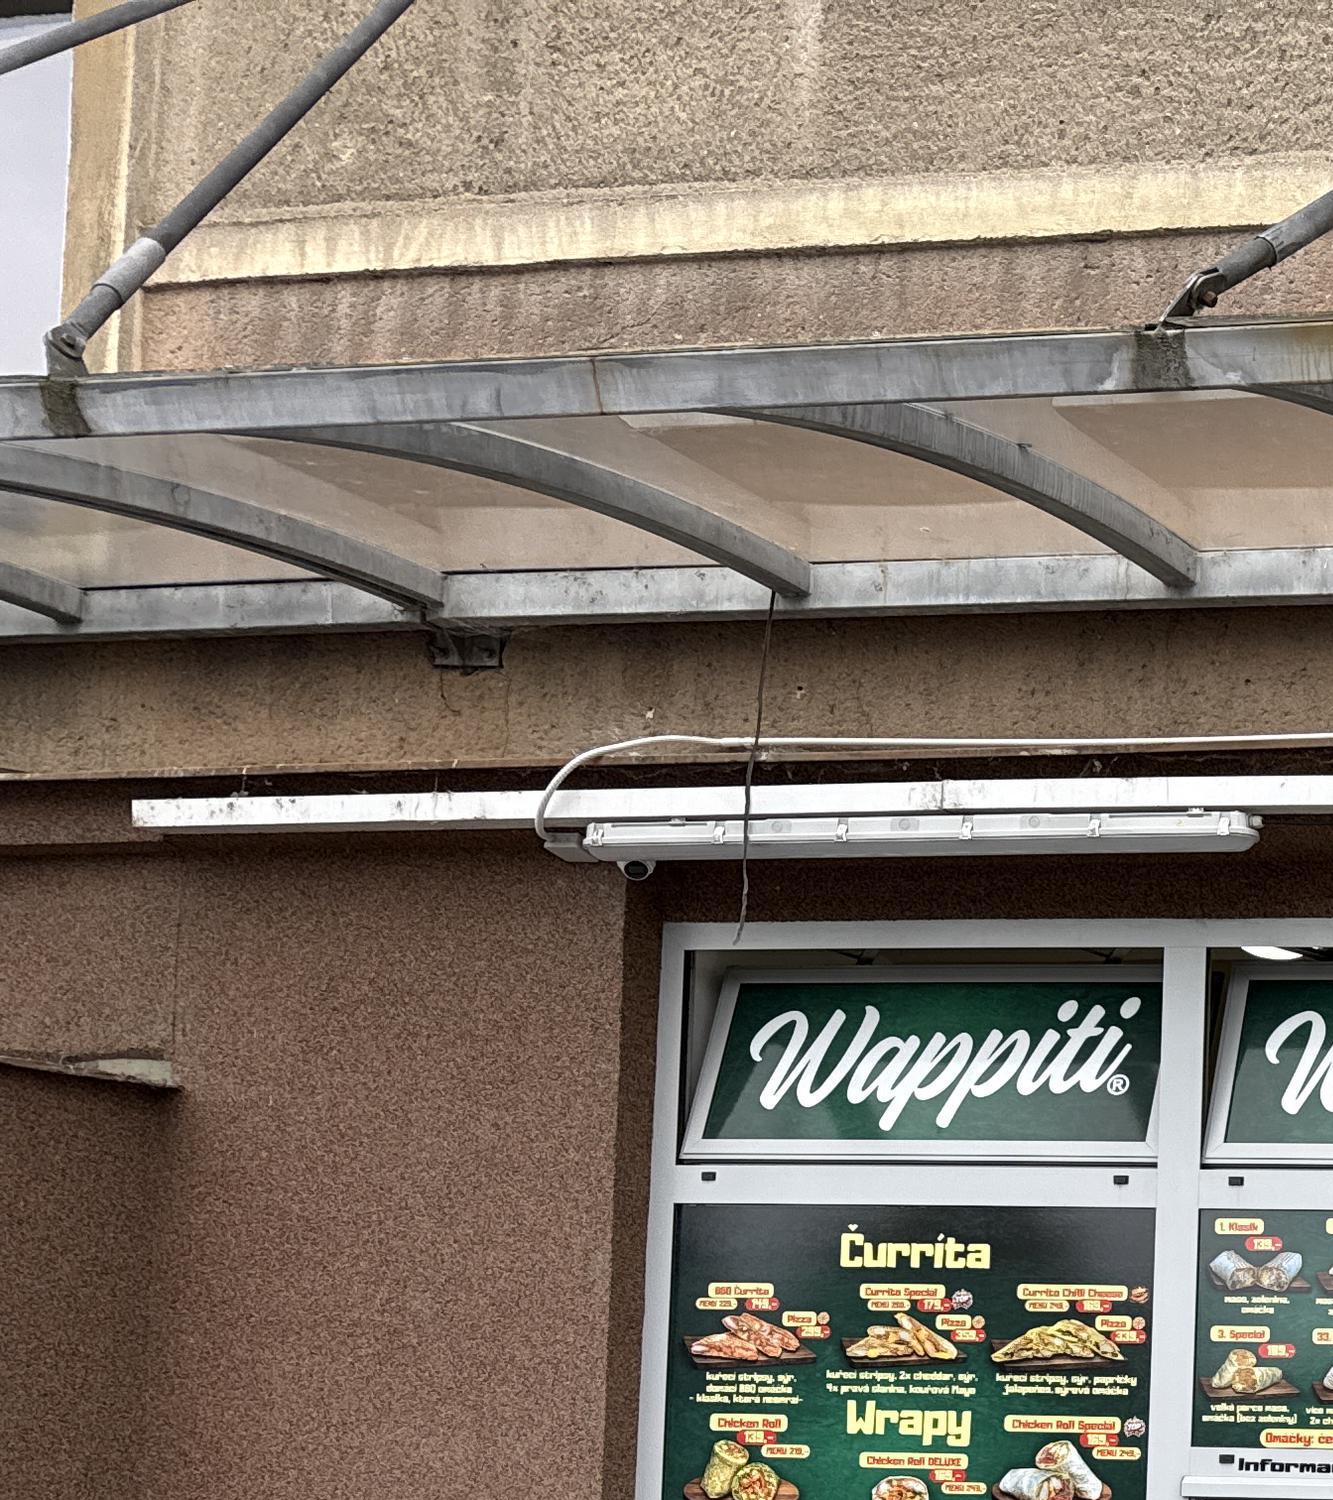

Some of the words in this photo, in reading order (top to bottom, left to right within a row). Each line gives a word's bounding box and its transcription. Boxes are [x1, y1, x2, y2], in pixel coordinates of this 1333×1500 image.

[717, 1417, 760, 1428] Chicken
[763, 1418, 781, 1428] Roll
[846, 1400, 972, 1448] Wrapy
[928, 1457, 962, 1466] DELUXE
